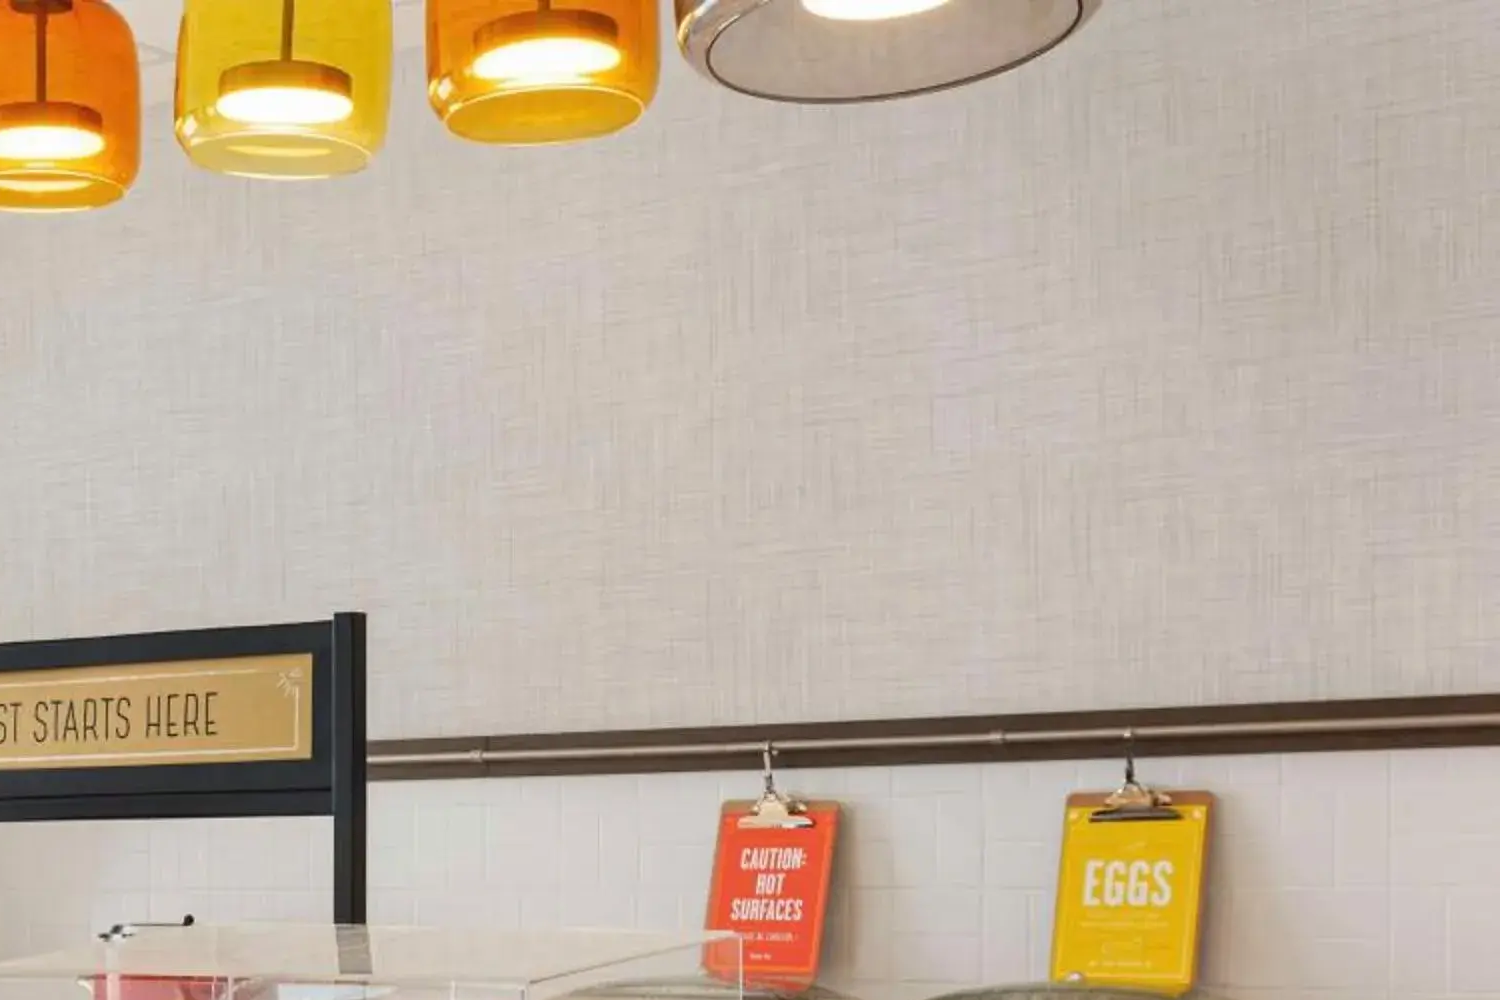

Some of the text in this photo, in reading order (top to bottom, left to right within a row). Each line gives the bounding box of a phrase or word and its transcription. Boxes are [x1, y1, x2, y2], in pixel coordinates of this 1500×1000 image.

[32, 697, 132, 743] STARTS
[145, 691, 220, 740] HERE
[740, 847, 808, 871] CAUTION:
[755, 872, 787, 896] HOT
[1082, 858, 1175, 908] EGGS
[729, 897, 804, 922] SURFACES
